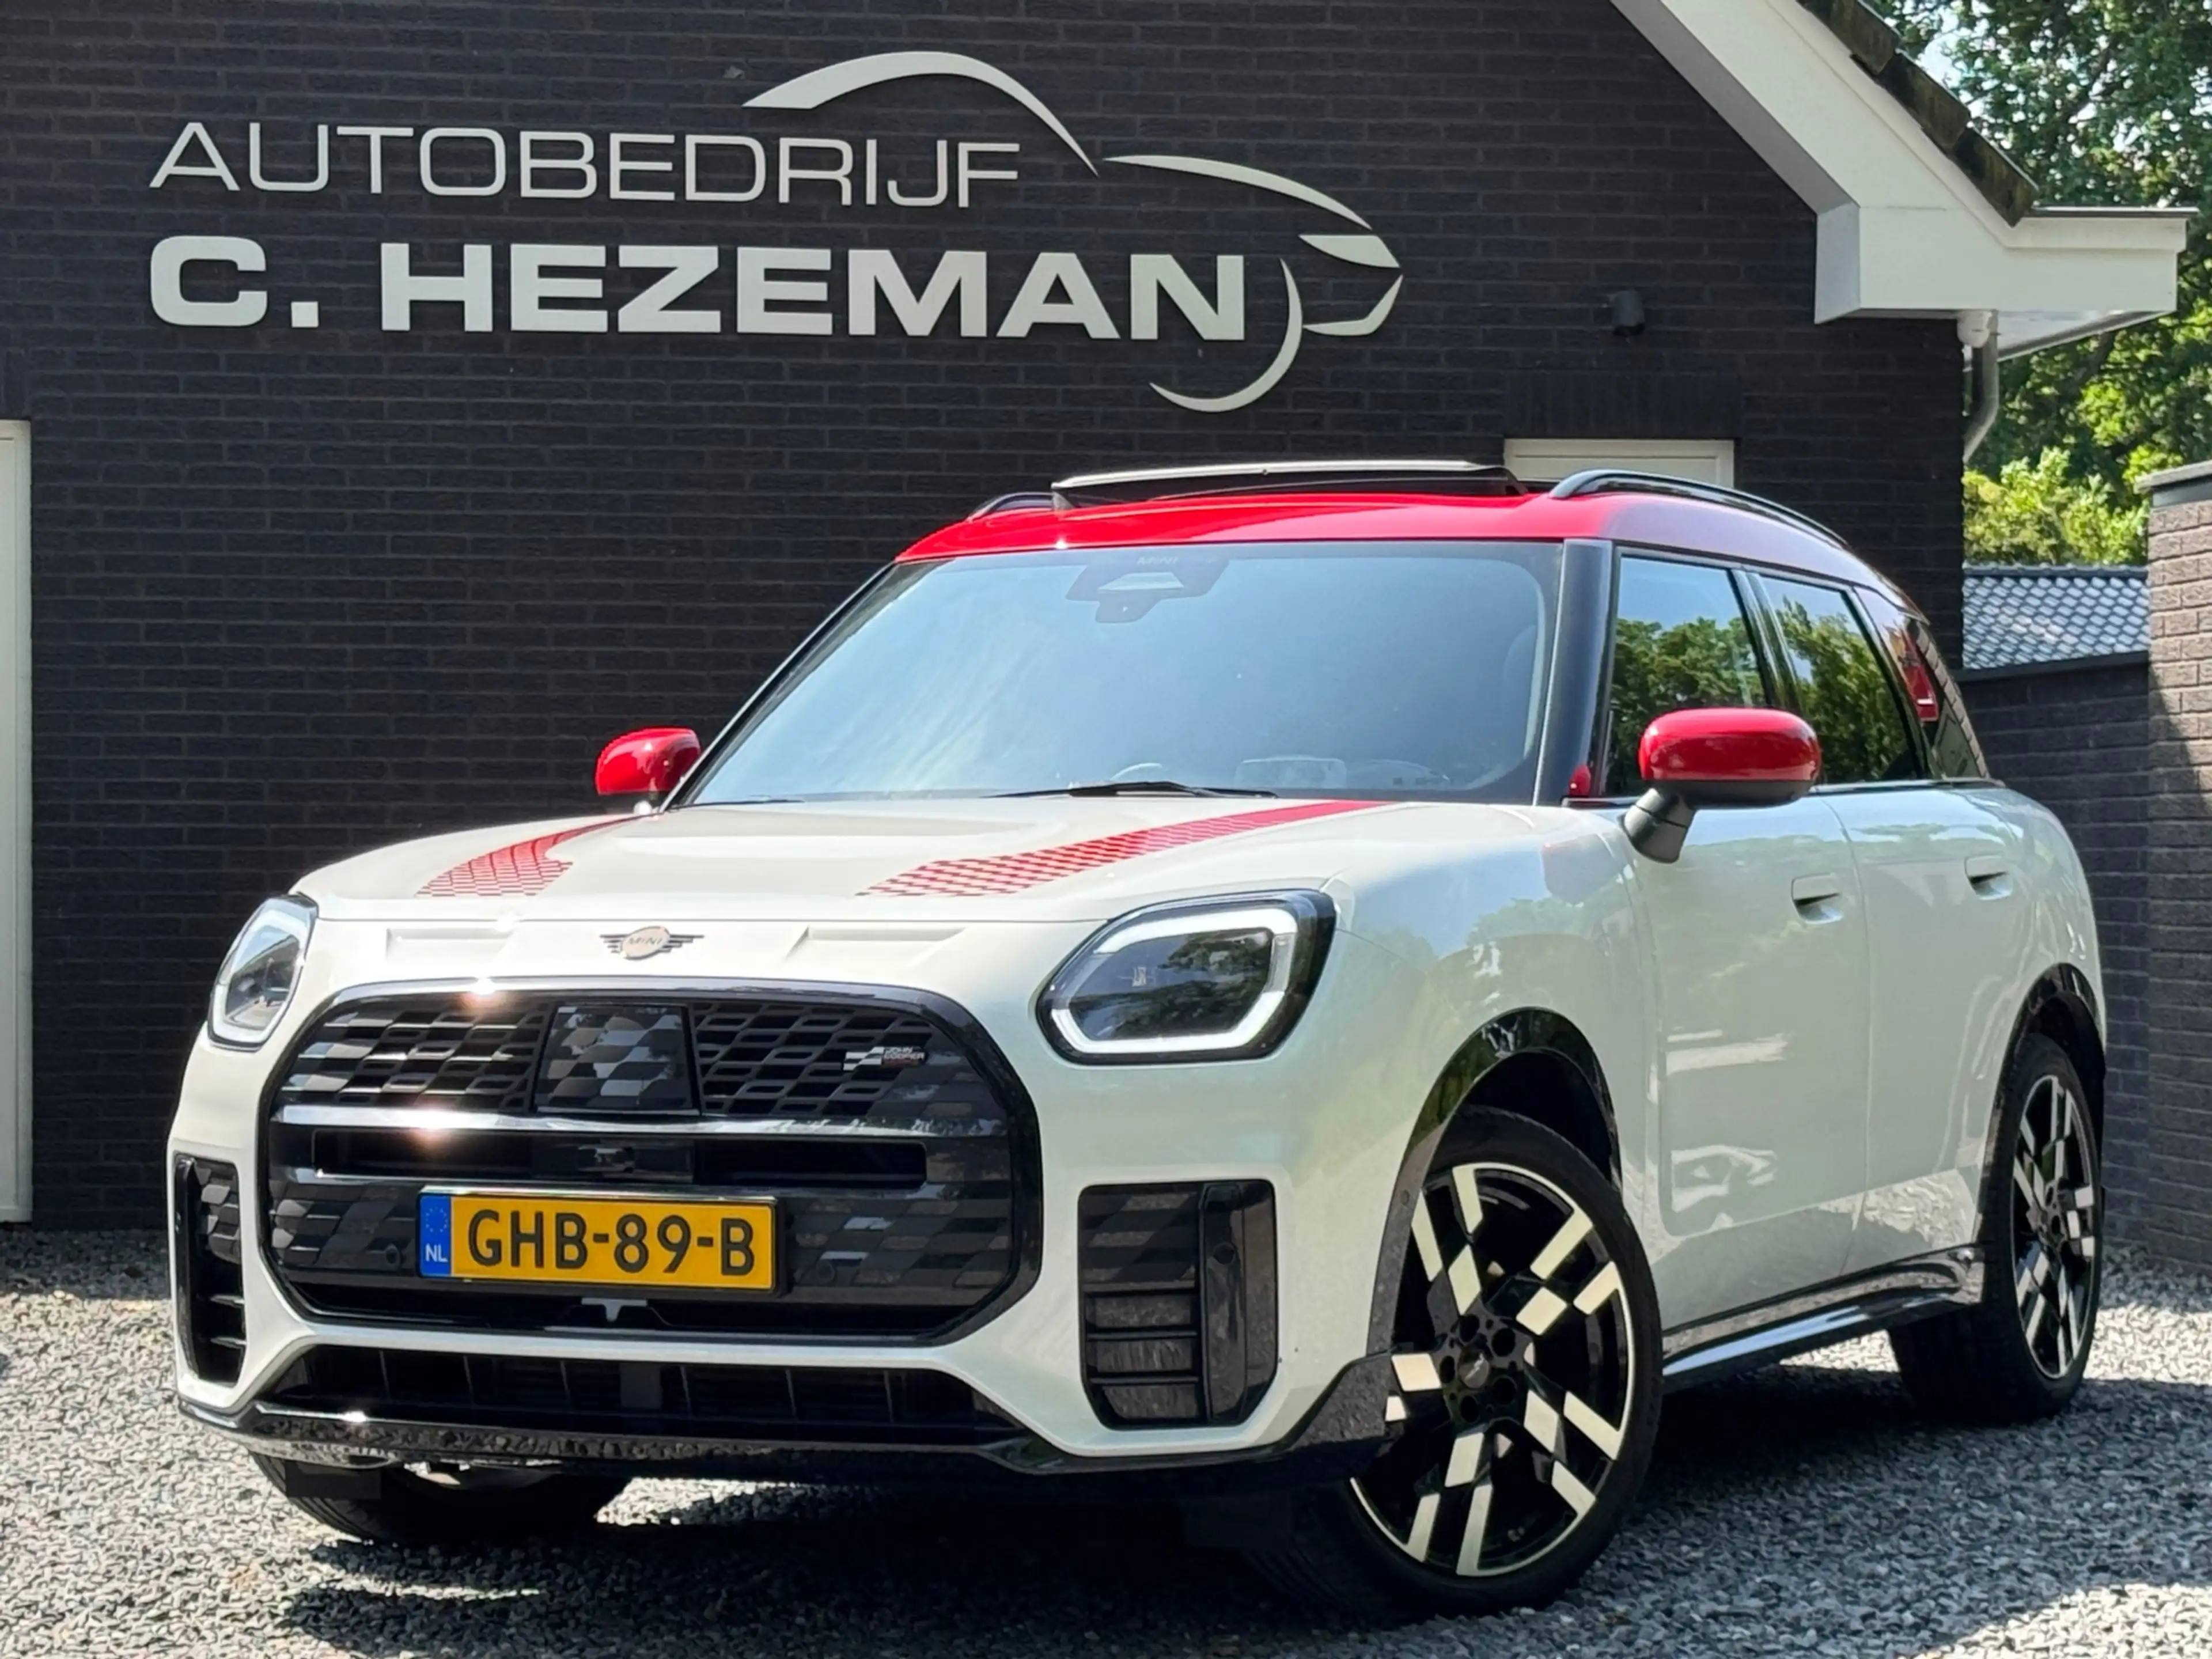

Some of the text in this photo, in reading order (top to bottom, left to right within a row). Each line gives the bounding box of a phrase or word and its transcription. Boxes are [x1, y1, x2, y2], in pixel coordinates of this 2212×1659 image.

[150, 122, 1020, 207] AUTOBEDRIJF
[151, 236, 1245, 340] C. HEZEMAN
[626, 937, 663, 945] MINI
[426, 1244, 448, 1262] NL
[467, 1208, 756, 1277] GHB-89-B
